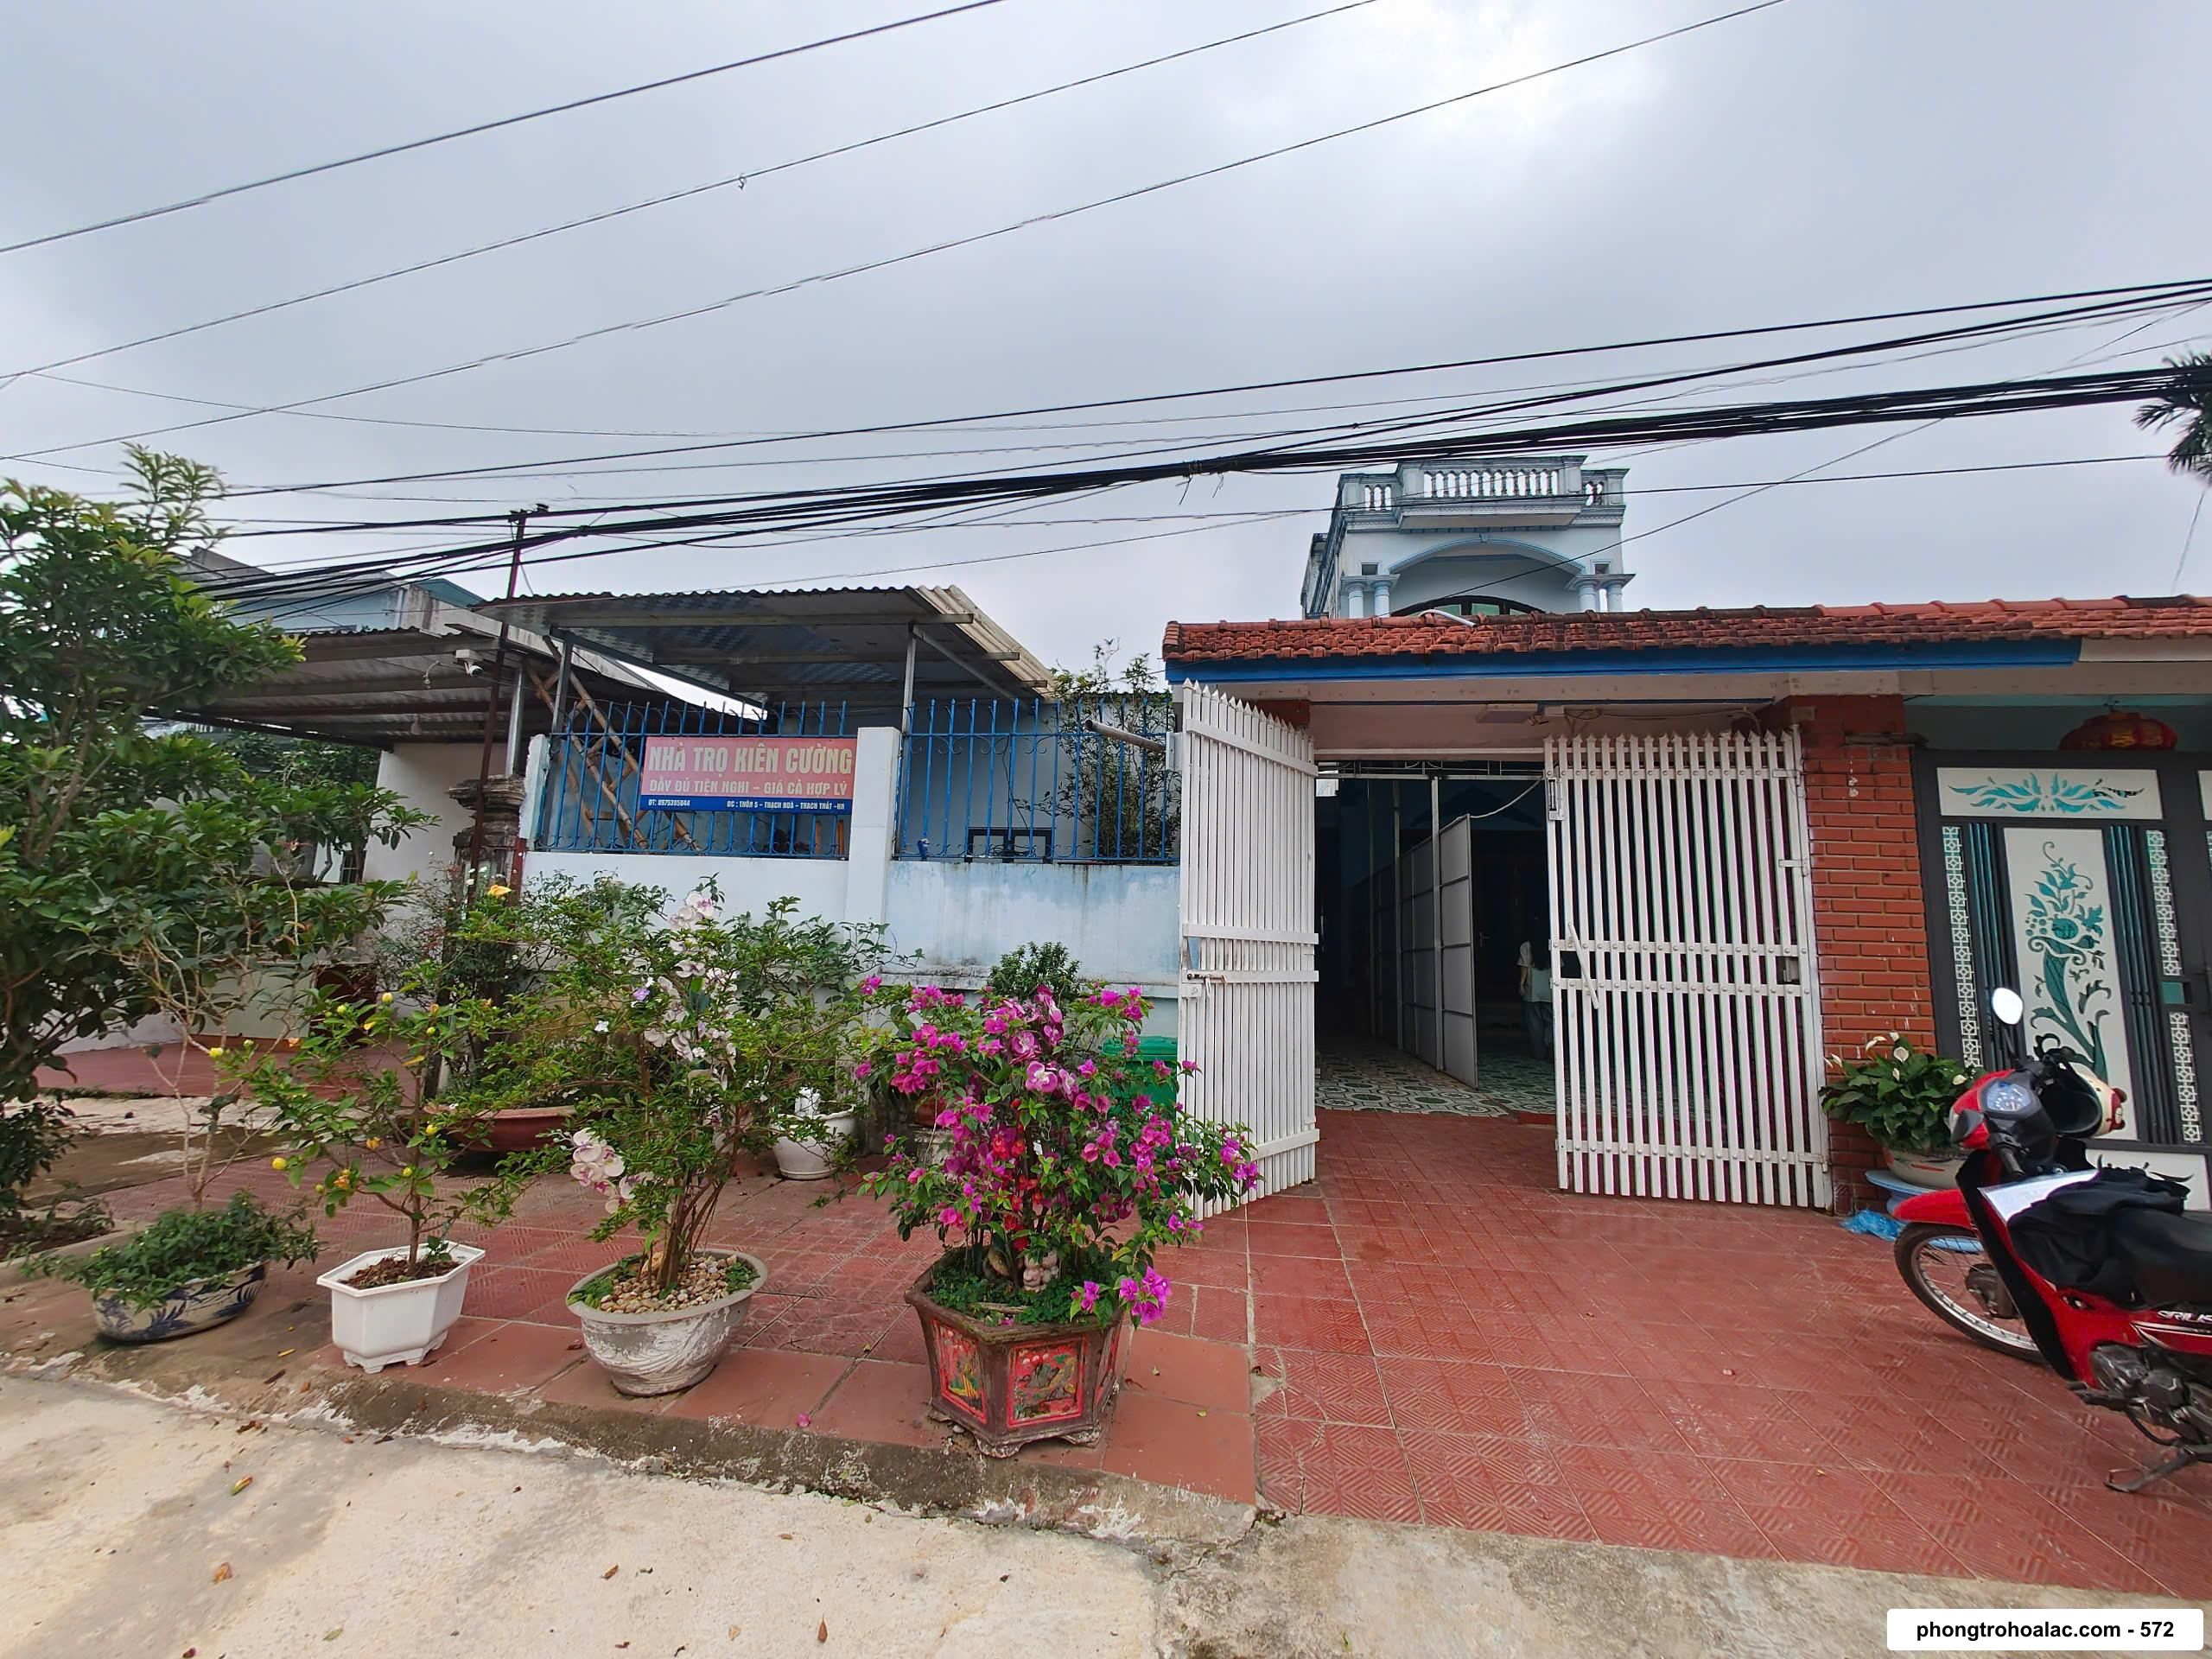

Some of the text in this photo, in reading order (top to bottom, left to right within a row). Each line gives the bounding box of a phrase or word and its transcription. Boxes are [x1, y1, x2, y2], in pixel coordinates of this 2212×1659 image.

[649, 742, 853, 778] NHÀ TRỌ KIÊN CƯỜNG
[721, 781, 749, 793] NGHI
[764, 779, 784, 795] GIÁ
[806, 781, 830, 798] HỢP
[834, 780, 848, 795] LÝ
